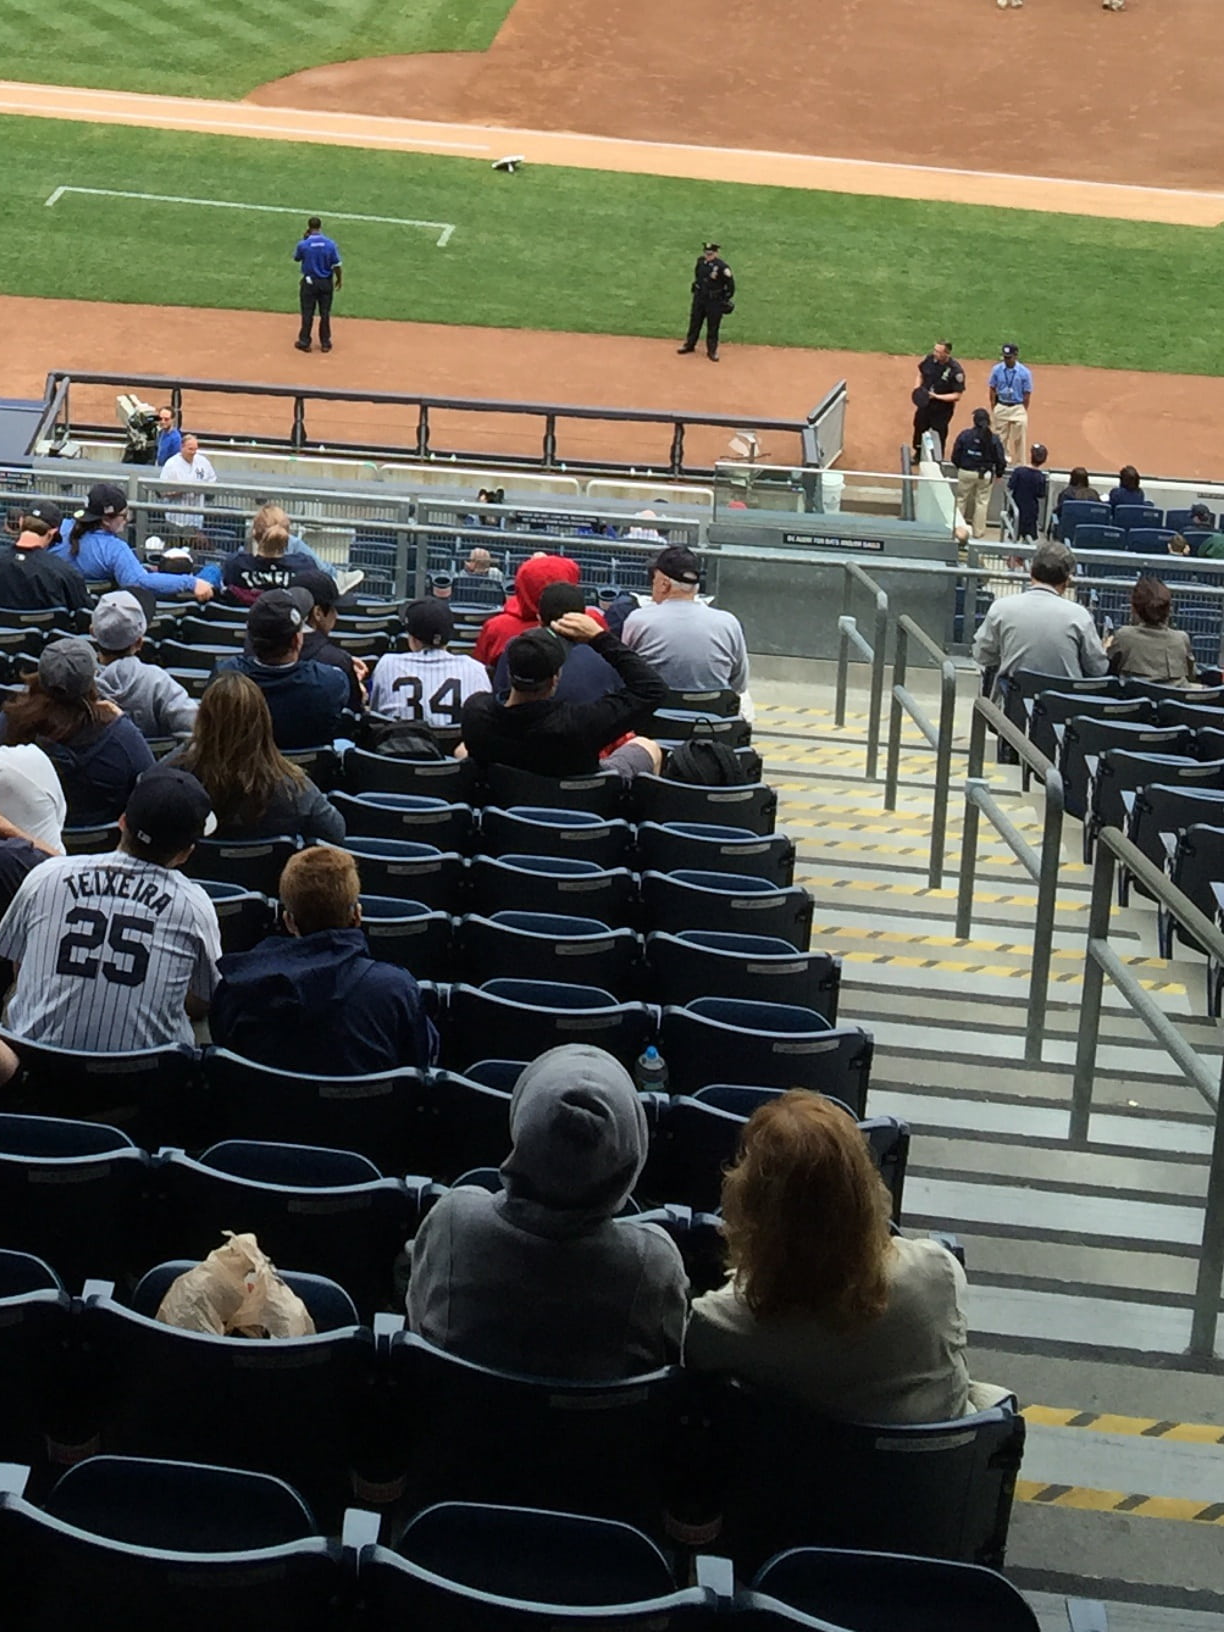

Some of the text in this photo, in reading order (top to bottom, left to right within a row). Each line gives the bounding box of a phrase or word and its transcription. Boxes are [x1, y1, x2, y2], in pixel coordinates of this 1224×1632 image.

[392, 676, 462, 725] 34
[63, 868, 173, 917] TEIXEIRA
[56, 905, 156, 988] 25
